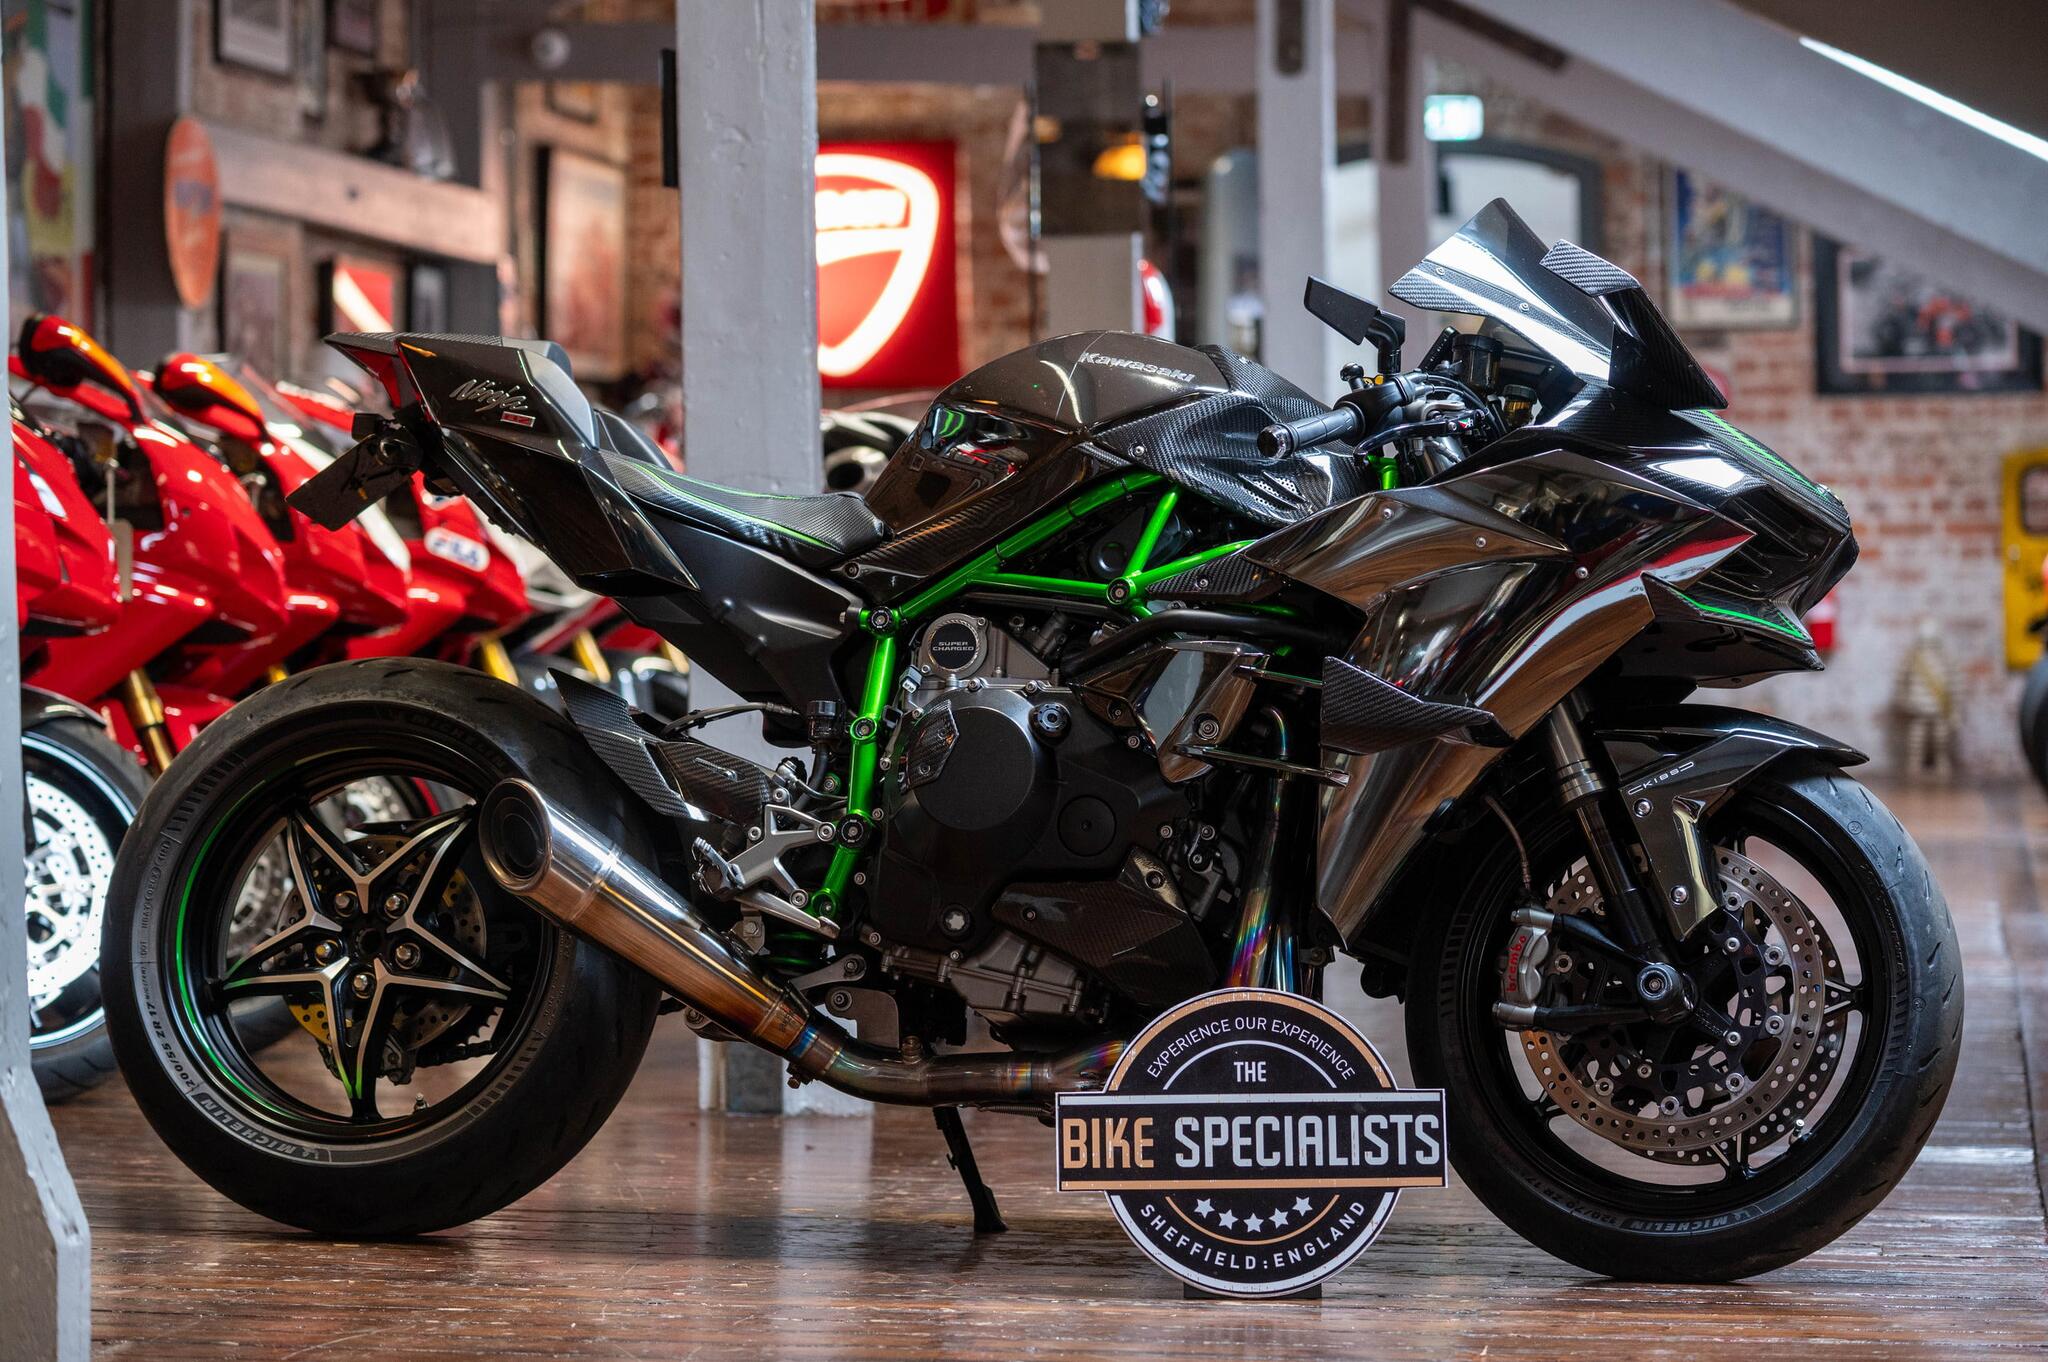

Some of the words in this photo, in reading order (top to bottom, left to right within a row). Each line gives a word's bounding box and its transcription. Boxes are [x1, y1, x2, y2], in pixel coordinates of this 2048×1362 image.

[1078, 352, 1196, 383] Kawasaki
[448, 379, 528, 413] Ninja
[1505, 935, 1527, 992] brembo
[152, 1022, 166, 1040] ZR
[1147, 1018, 1231, 1078] EXPERIENCE
[1235, 1016, 1267, 1031] OUR
[1271, 1019, 1356, 1081] EXPERIENCE
[161, 1042, 196, 1088] 200/55
[1233, 1061, 1267, 1083] THE
[200, 1098, 297, 1155] MICHELIN
[1062, 1117, 1155, 1169] BIKE
[1174, 1114, 1441, 1168] SPECIALISTS
[1629, 1215, 1729, 1232] MICHELIN
